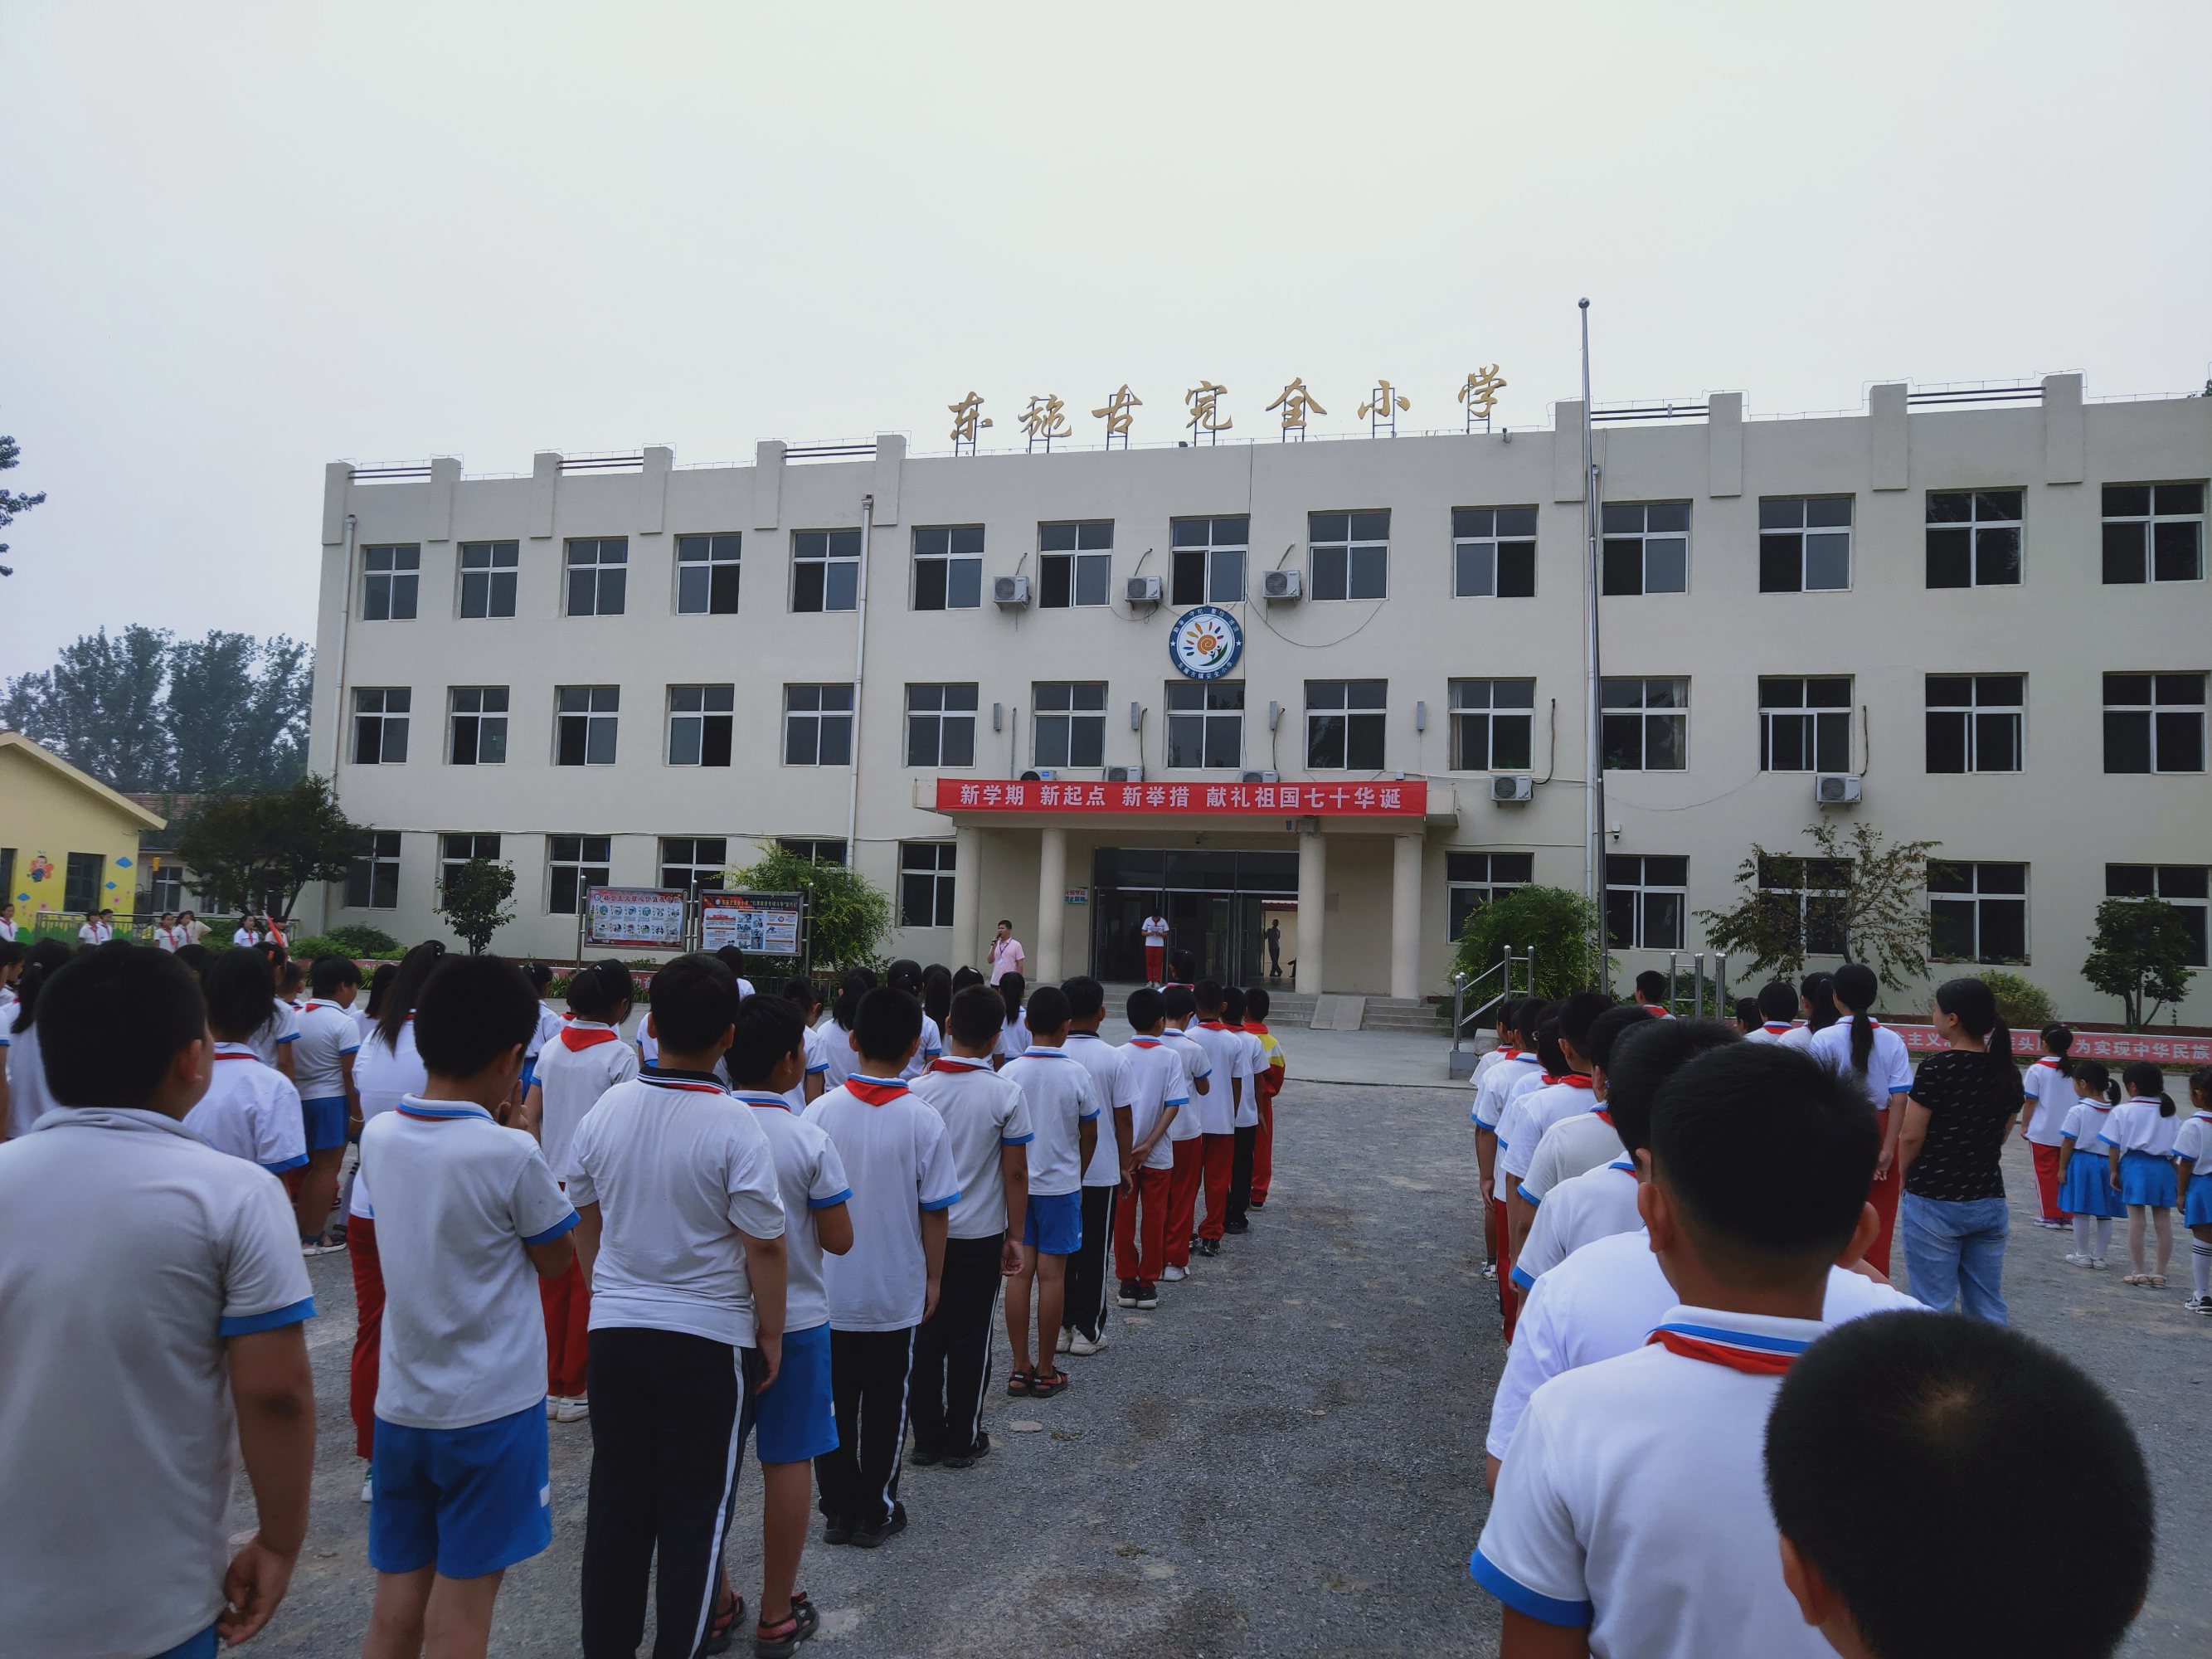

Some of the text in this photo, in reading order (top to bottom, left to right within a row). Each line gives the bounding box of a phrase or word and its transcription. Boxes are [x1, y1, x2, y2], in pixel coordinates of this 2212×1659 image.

[960, 784, 1402, 810] 新学期 新起点 新举措 献礼祖国七十华诞
[2075, 1039, 2210, 1061] 为实现中华民族
